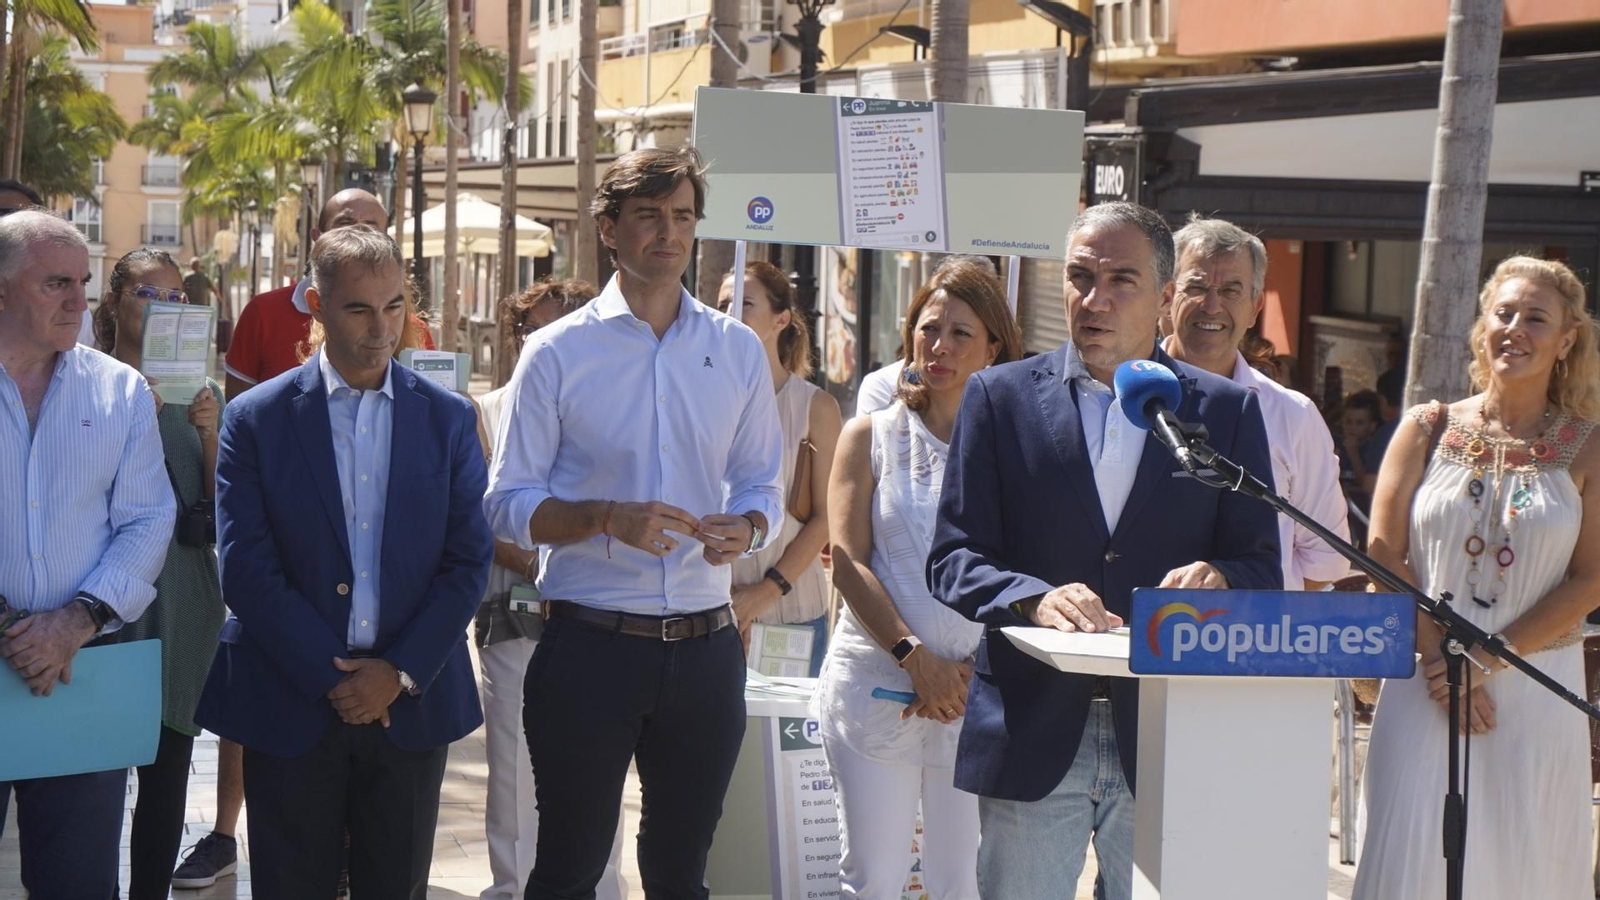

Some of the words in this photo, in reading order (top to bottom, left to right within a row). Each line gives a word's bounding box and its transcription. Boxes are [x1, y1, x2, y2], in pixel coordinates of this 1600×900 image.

[1095, 165, 1124, 195] EURO
[1172, 614, 1385, 662] populares
[800, 760, 812, 768] ¿Te
[813, 798, 832, 806] salud
